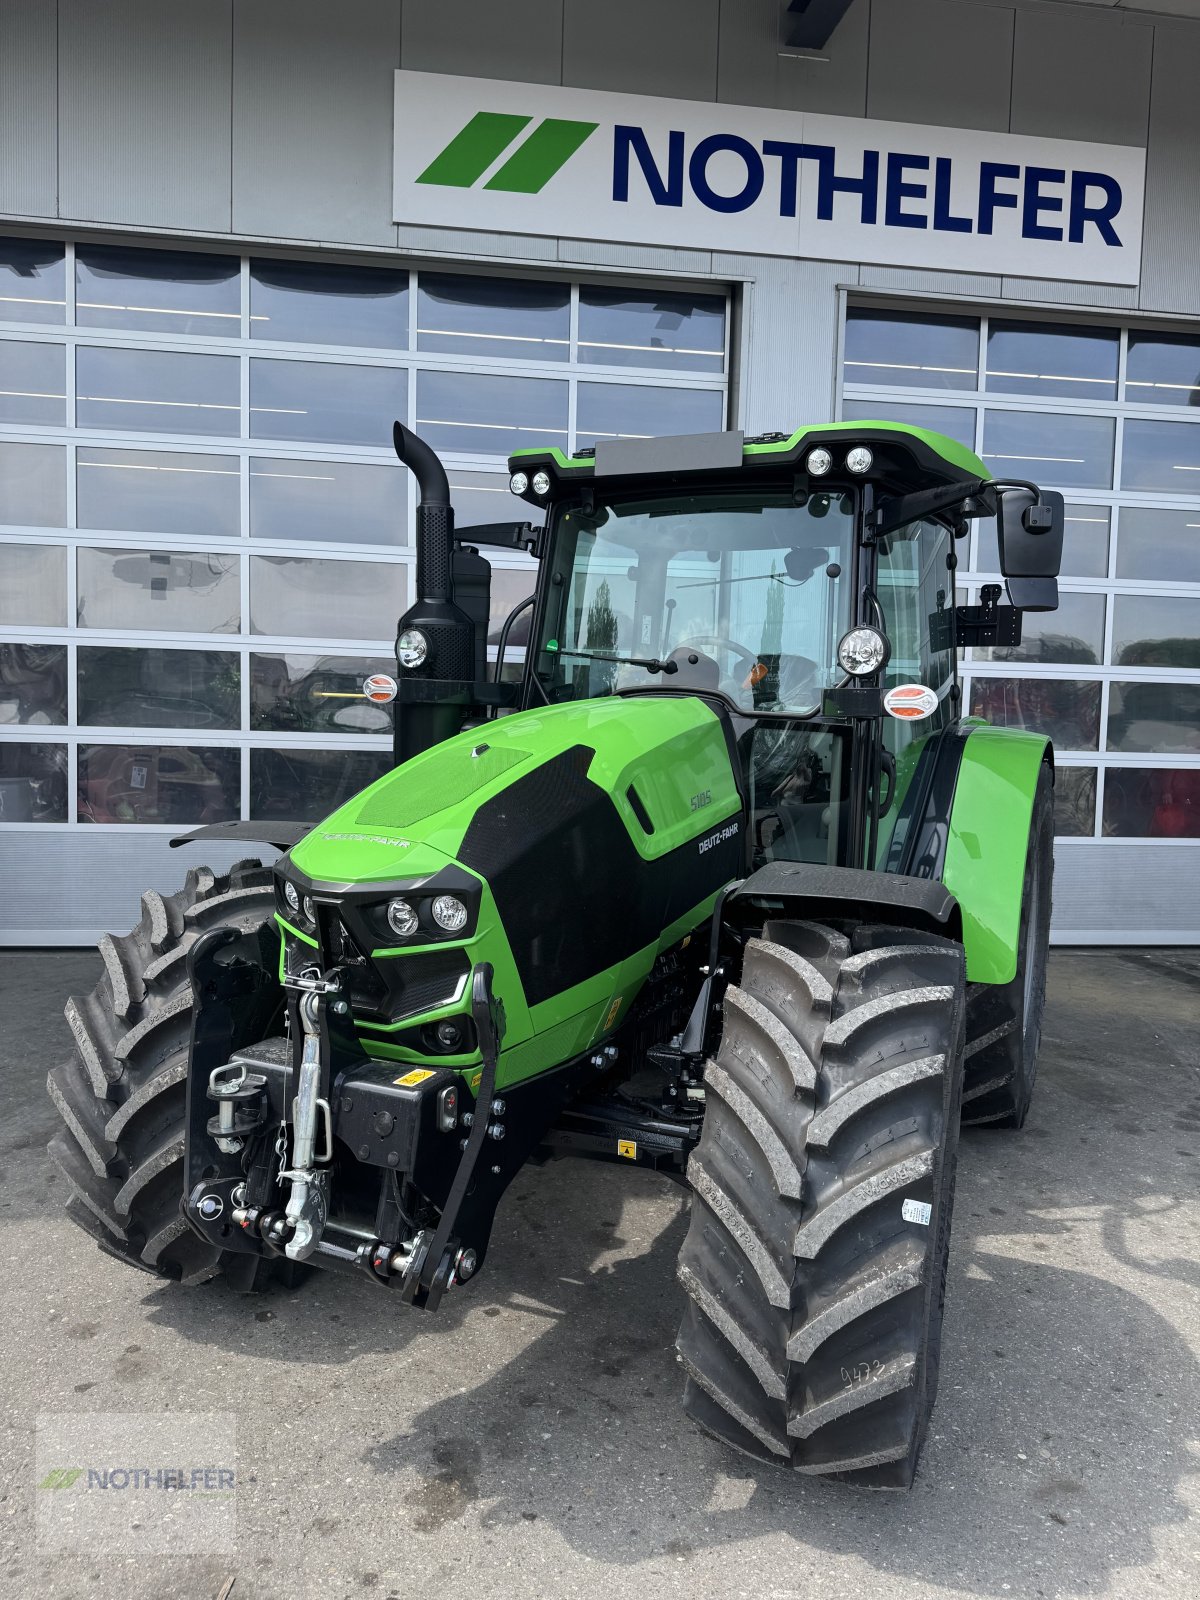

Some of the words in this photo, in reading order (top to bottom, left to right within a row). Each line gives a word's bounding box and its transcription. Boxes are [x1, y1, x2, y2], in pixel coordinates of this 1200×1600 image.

[612, 124, 1123, 247] NOTHELFER
[698, 822, 739, 855] DEUTZ-FAHR
[854, 1166, 910, 1204] RADIAL
[840, 1359, 886, 1389] 9473
